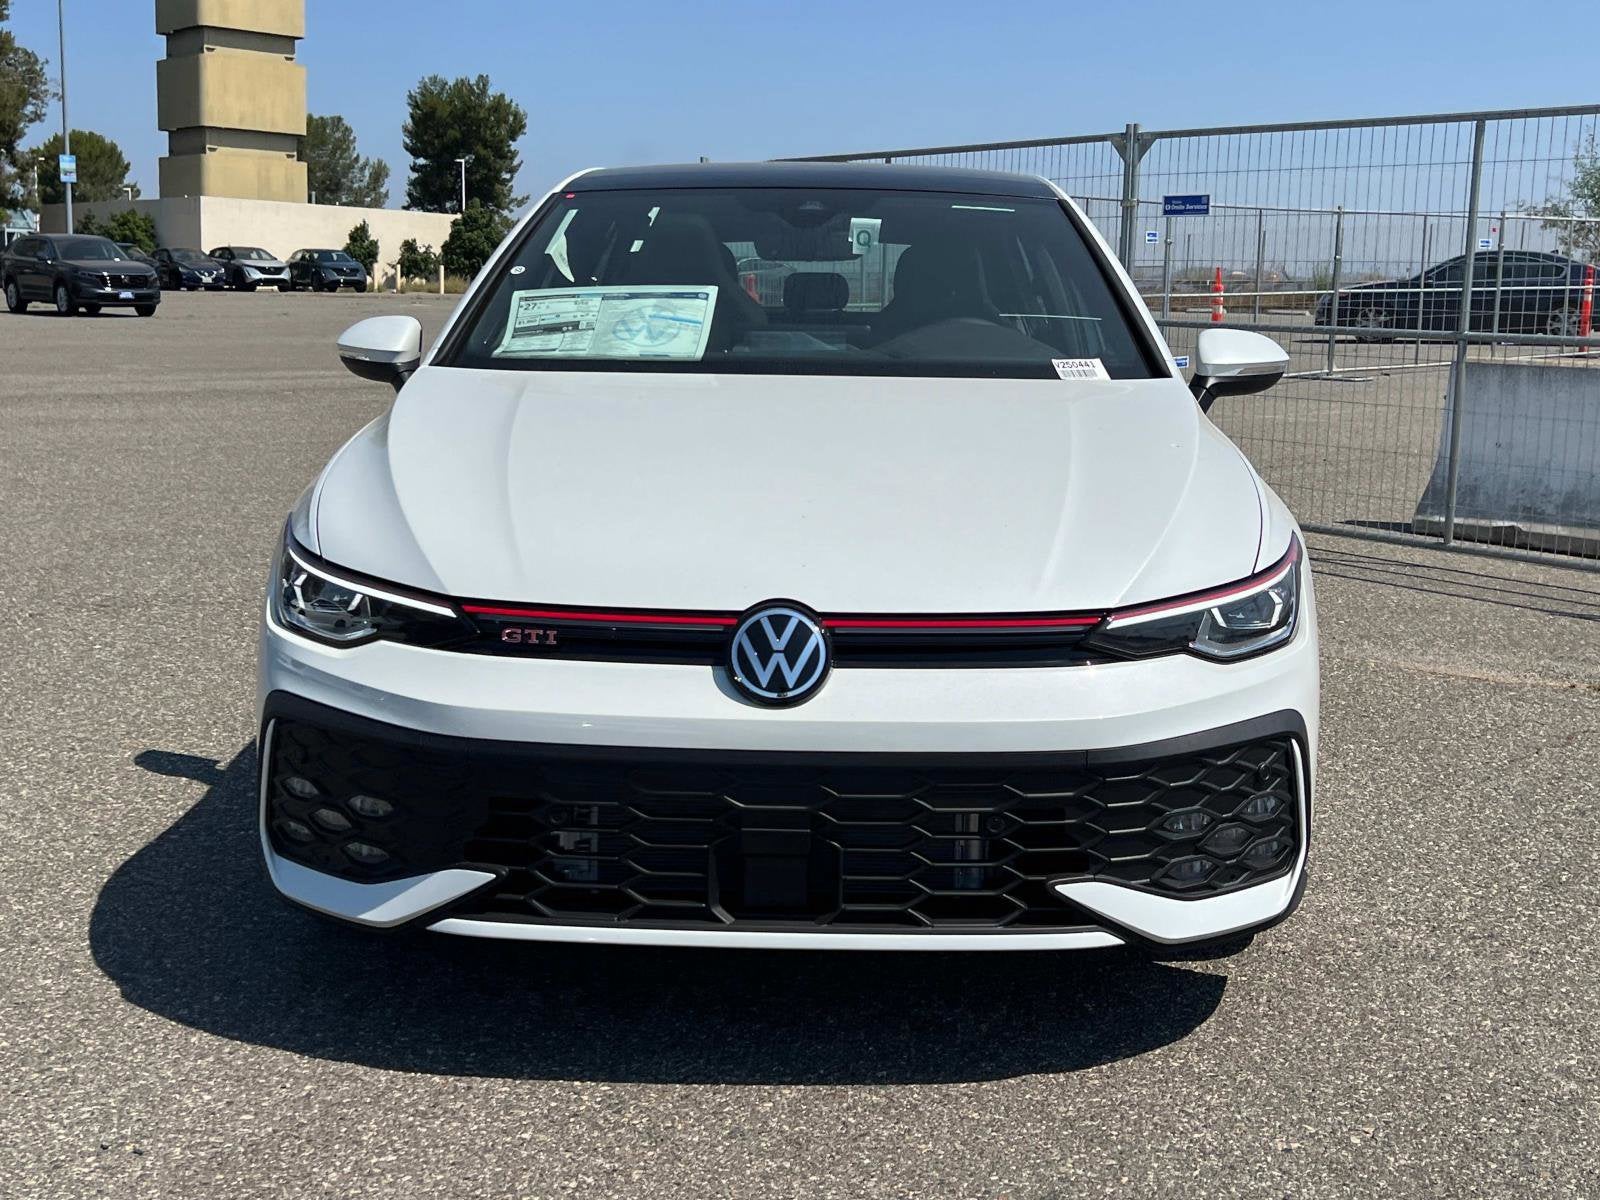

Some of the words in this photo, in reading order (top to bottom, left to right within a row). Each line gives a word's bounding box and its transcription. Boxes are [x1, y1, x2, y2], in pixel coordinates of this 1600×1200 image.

[856, 230, 871, 248] Q
[501, 627, 557, 645] GTI
[738, 615, 820, 689] VW
